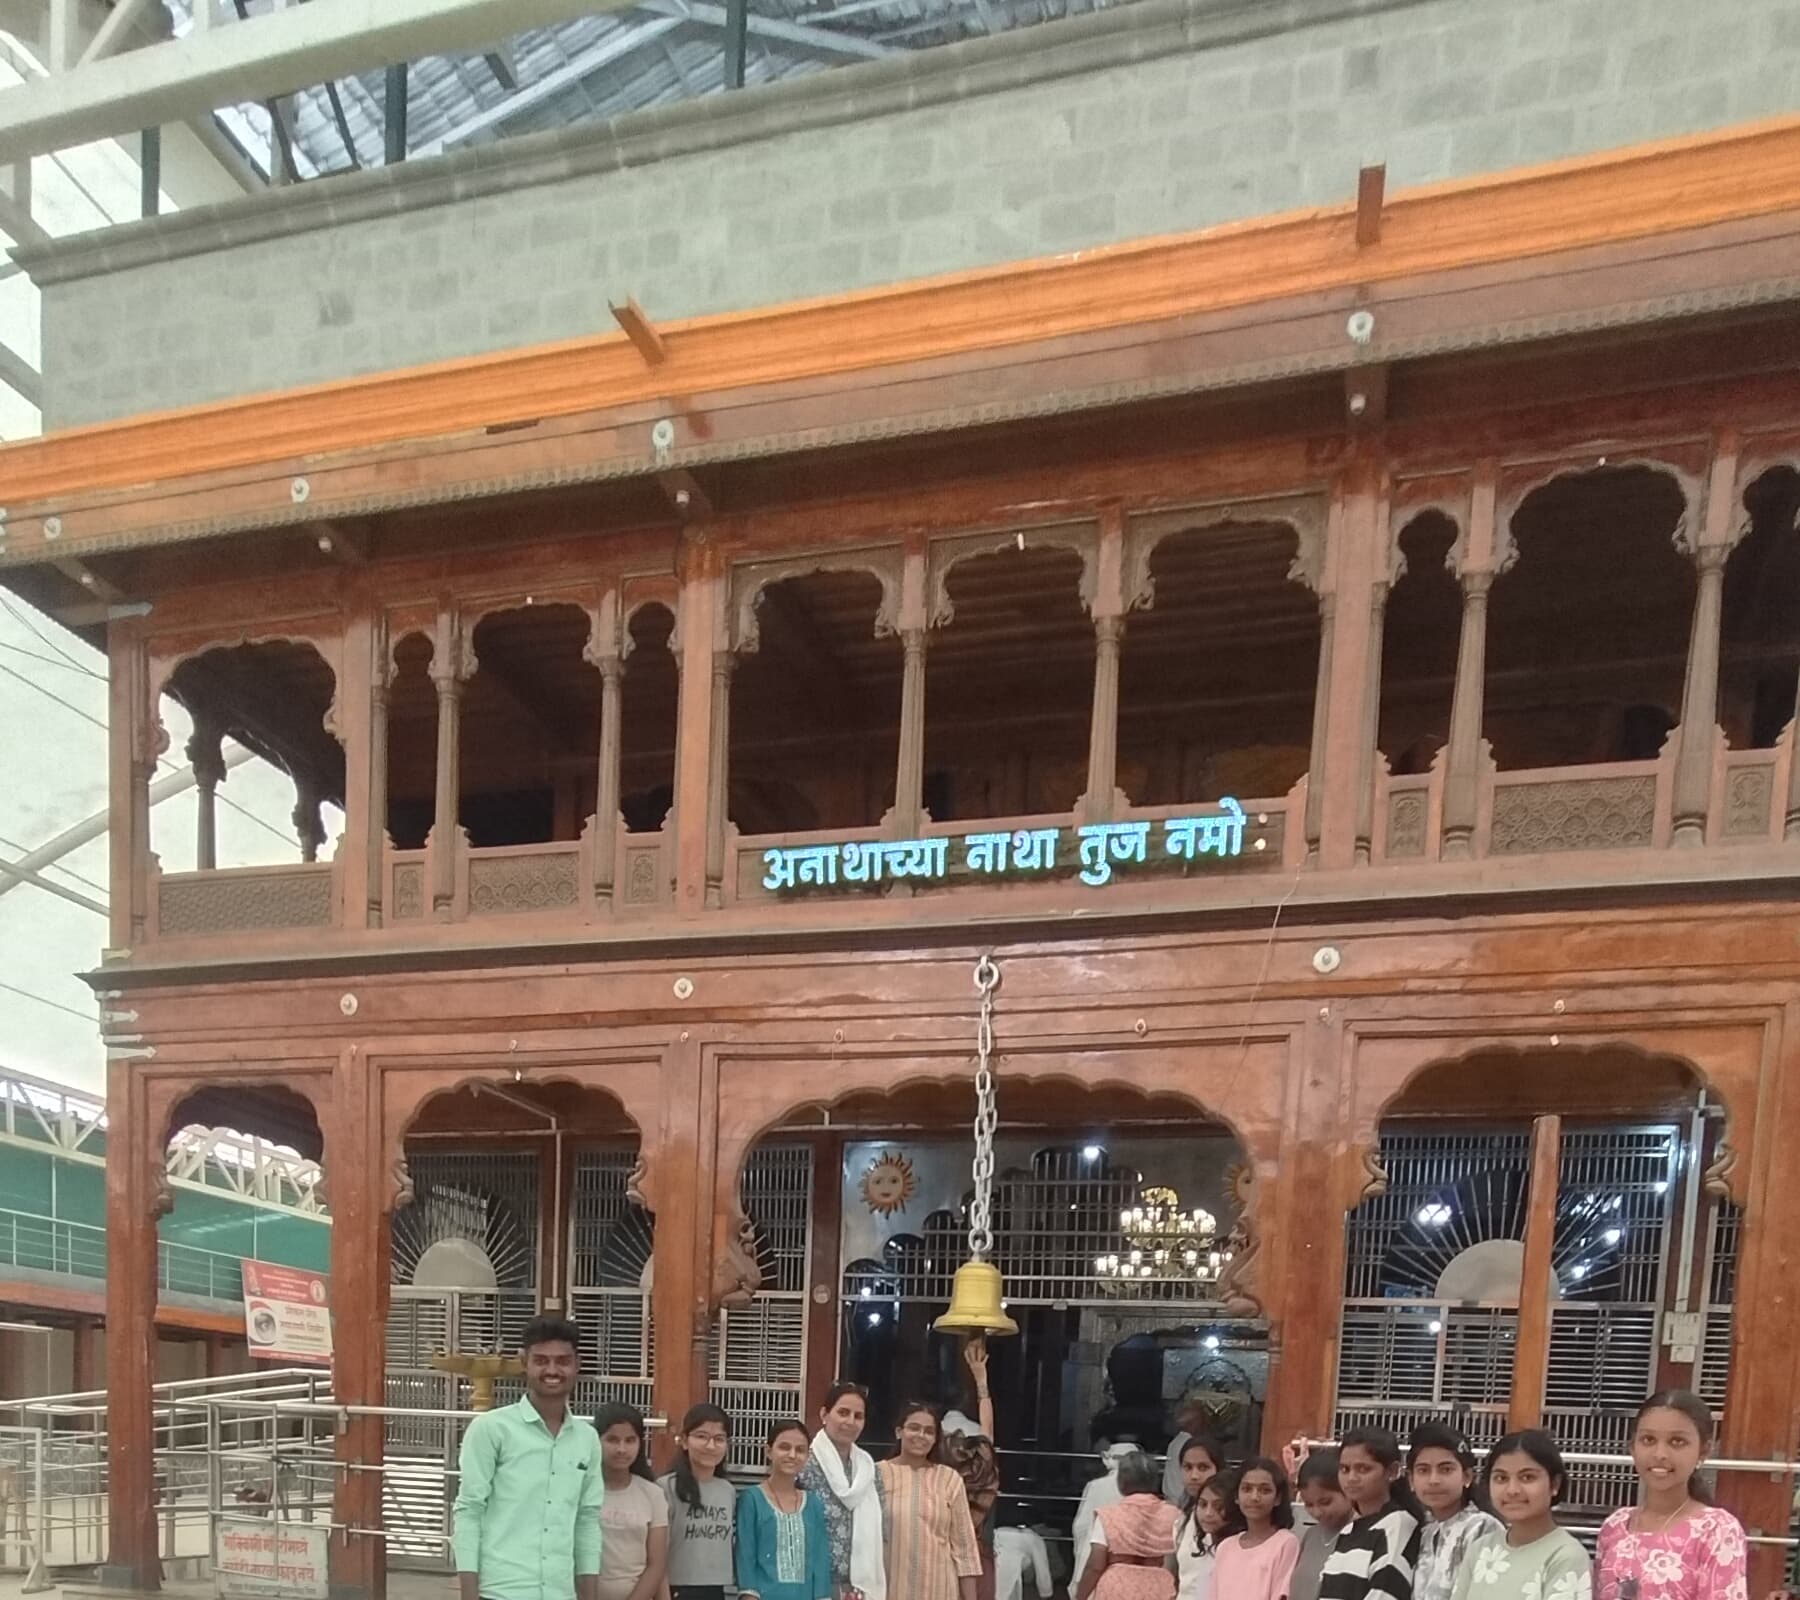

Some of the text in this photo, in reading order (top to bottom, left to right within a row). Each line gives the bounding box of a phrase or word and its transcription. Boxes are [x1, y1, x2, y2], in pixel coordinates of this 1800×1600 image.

[763, 837, 949, 889] अनाथाच्या
[966, 829, 1059, 872] नाथा
[1079, 821, 1150, 885] तुज
[684, 1523, 731, 1540] HUNGRY
